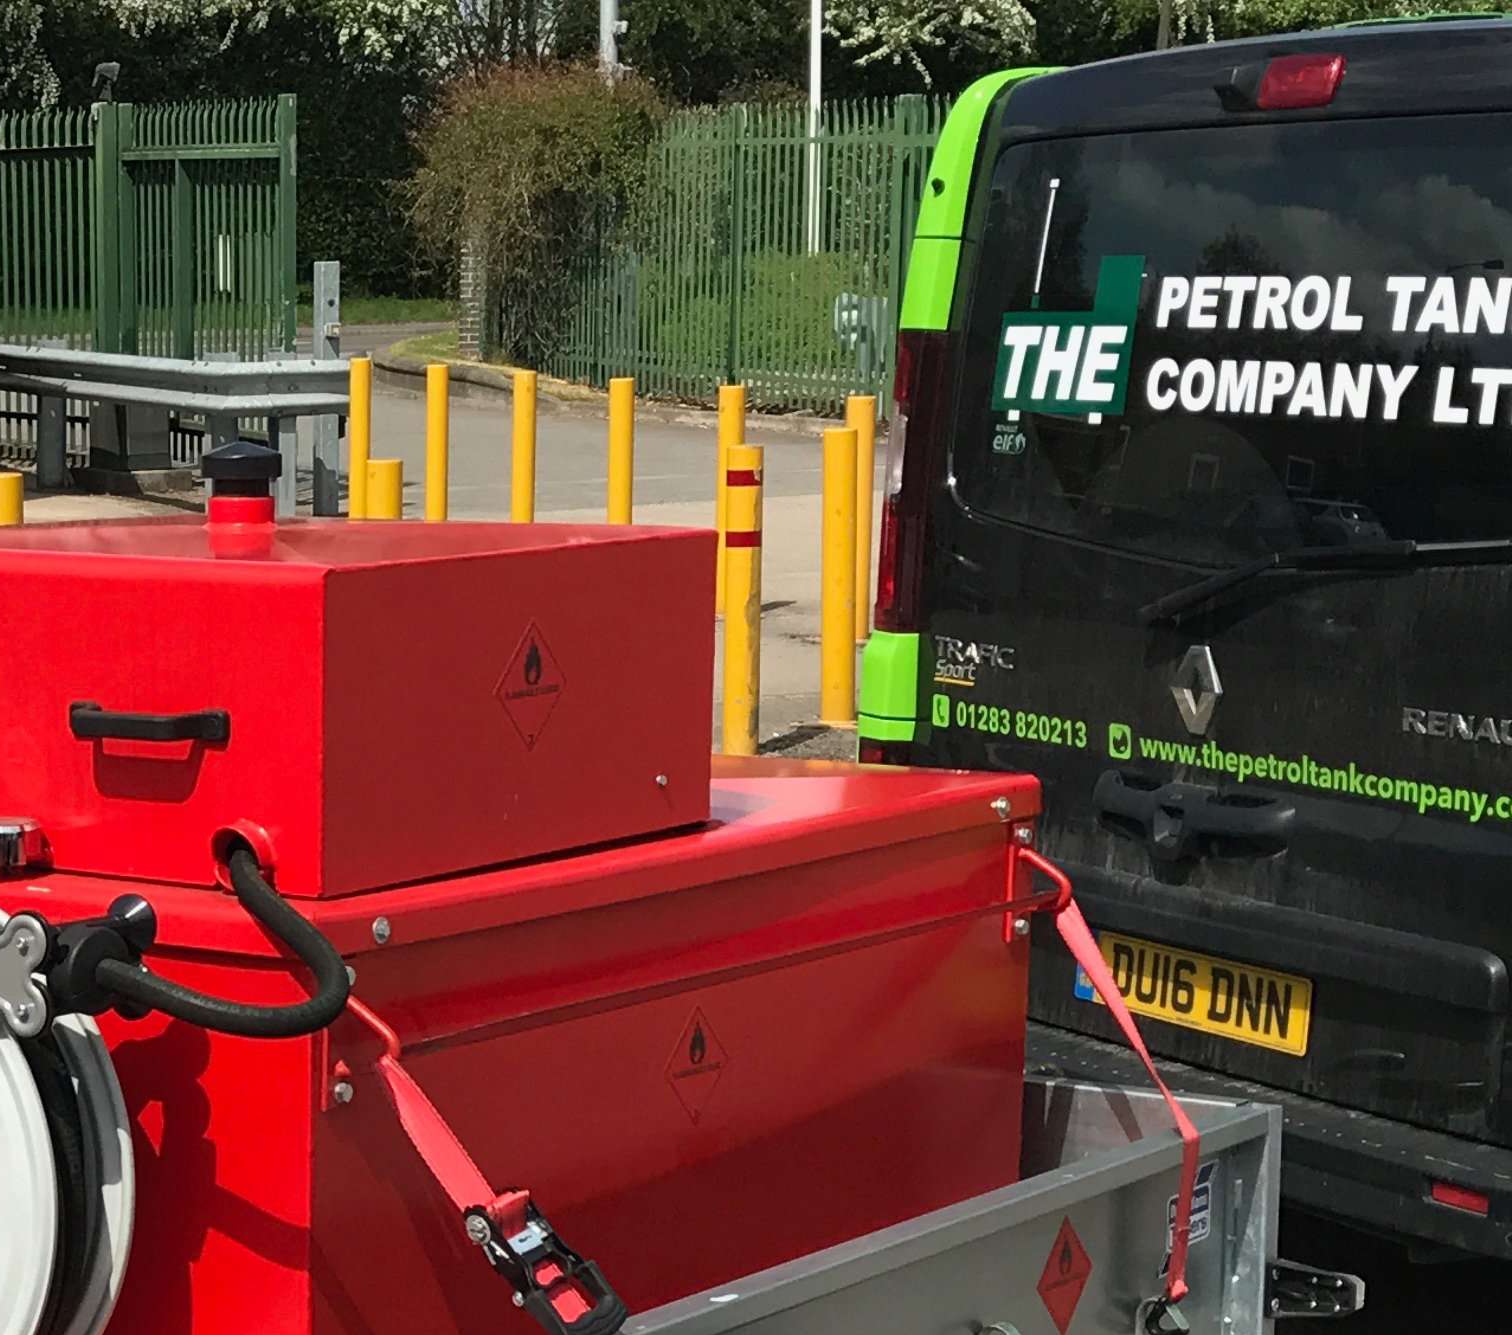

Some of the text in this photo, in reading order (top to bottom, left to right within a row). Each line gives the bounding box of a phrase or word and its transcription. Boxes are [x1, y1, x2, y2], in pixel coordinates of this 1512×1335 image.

[1155, 275, 1512, 335] PETROL TAN
[1002, 325, 1128, 403] THE
[1146, 357, 1512, 425] COMPANY LT
[934, 658, 976, 681] Sport
[935, 634, 1015, 670] TRAFIC
[956, 700, 1087, 748] 01283 820213
[1139, 737, 1512, 823] www.thepetroltankcompany.c
[1112, 942, 1292, 1040] DU16 DNN
